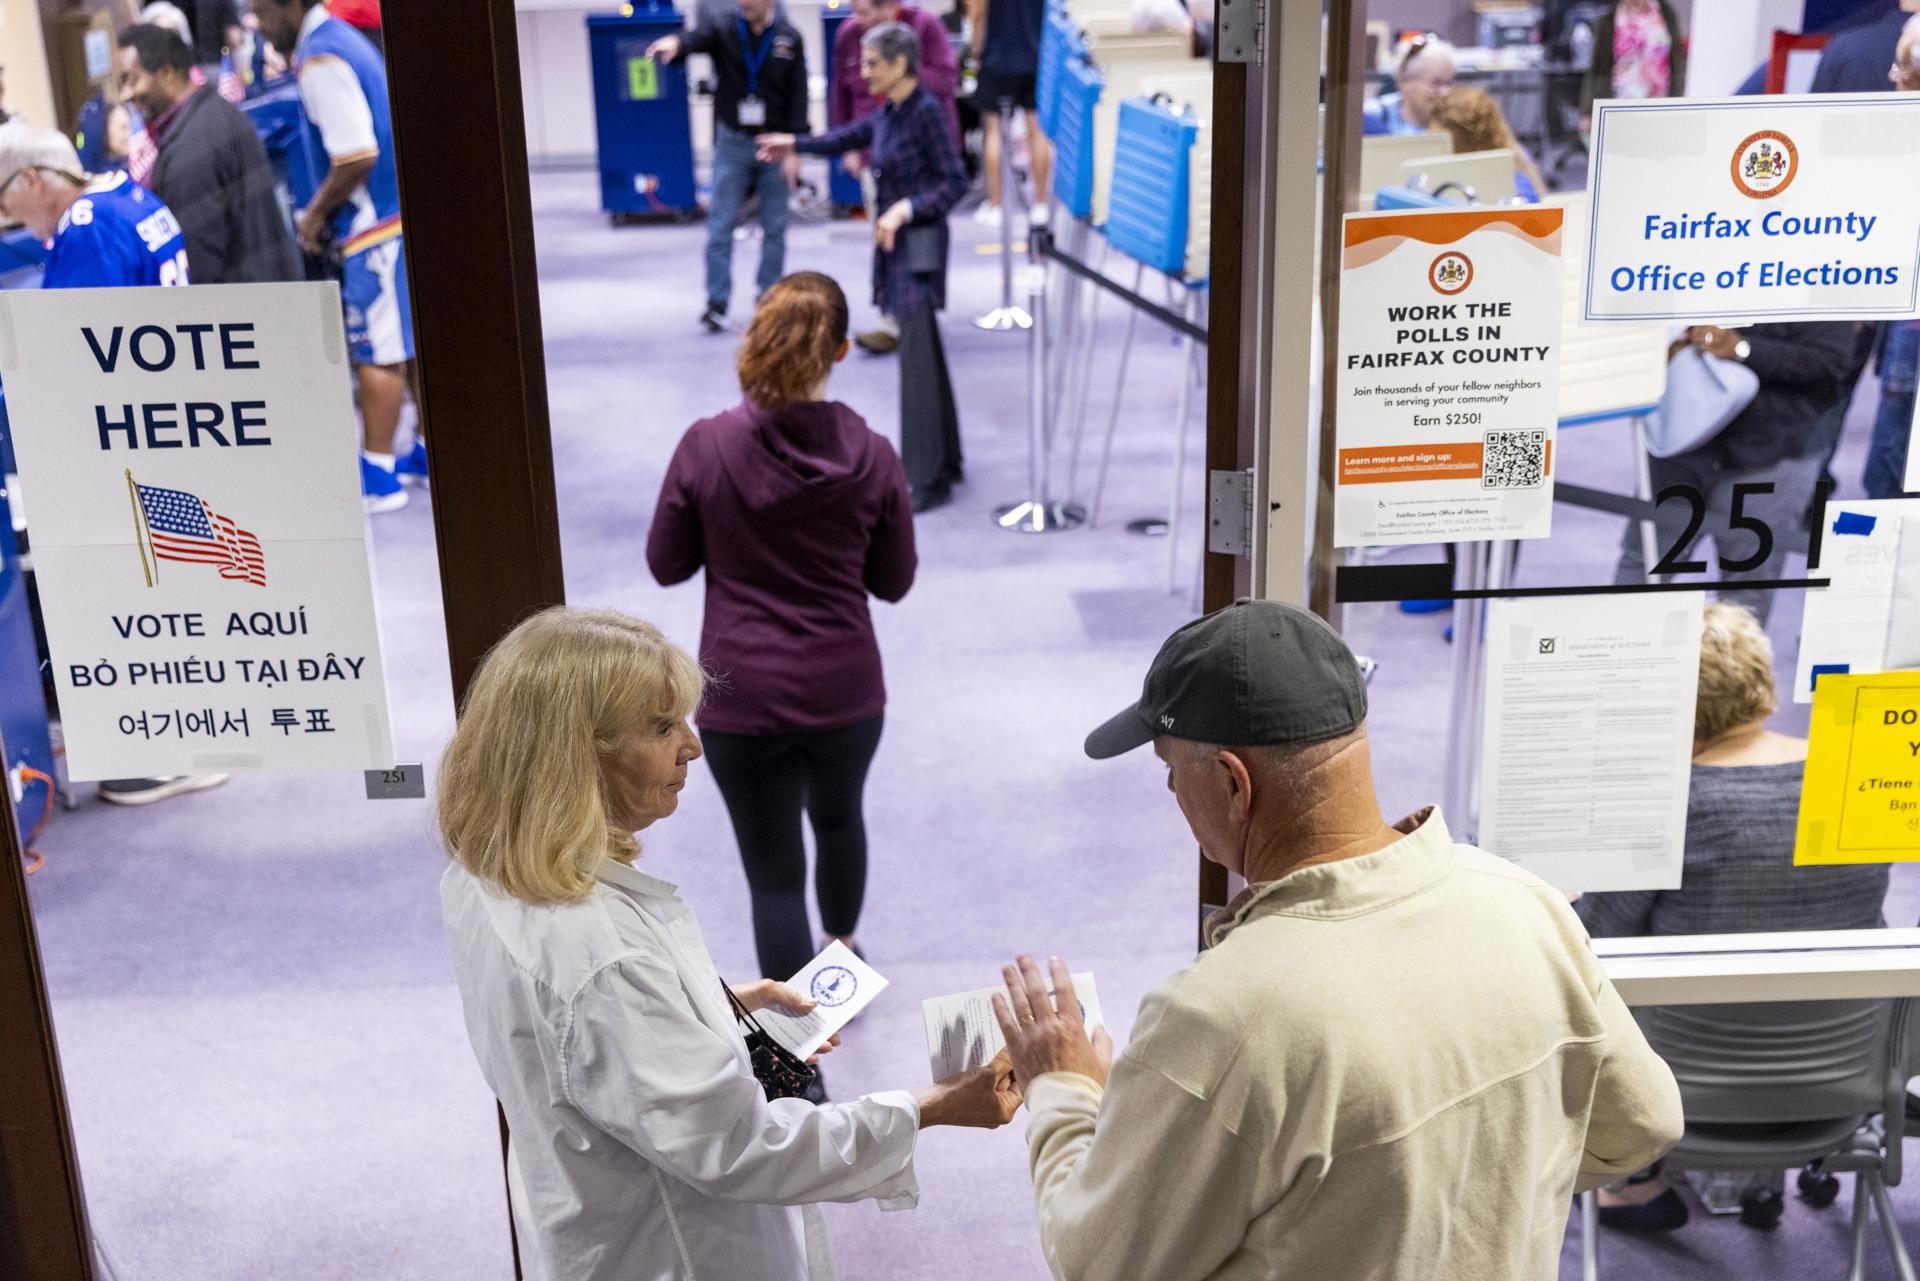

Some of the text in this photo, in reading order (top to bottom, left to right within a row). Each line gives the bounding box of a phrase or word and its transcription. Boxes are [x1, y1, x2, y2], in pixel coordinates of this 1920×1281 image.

[1645, 211, 1876, 241] Fairfax County
[1611, 260, 1898, 291] Office of Elections
[1388, 303, 1511, 322] WORK THE
[1397, 326, 1500, 344] POLLS IN
[81, 323, 260, 373] VOTE
[1348, 347, 1549, 369] FAIRFAX COUNTY
[1354, 380, 1541, 396] Join thousands of your fellow neighbors
[1385, 394, 1508, 407] in serving your community
[95, 401, 271, 450] HERE
[1414, 413, 1481, 426] Earn $250!
[1344, 452, 1453, 466] Learn more and sign up:
[1395, 507, 1489, 519] Fairfax County Office of Elections
[1649, 482, 1829, 573] 251
[112, 606, 307, 638] VOTE AQUÍ
[70, 653, 364, 688] BỎ PHIẾU TẠI ĐÂY
[119, 708, 335, 739] 여기에서 투표
[1884, 710, 1917, 725] DO
[382, 771, 405, 783] 251
[1859, 779, 1912, 791] ¿Tiene
